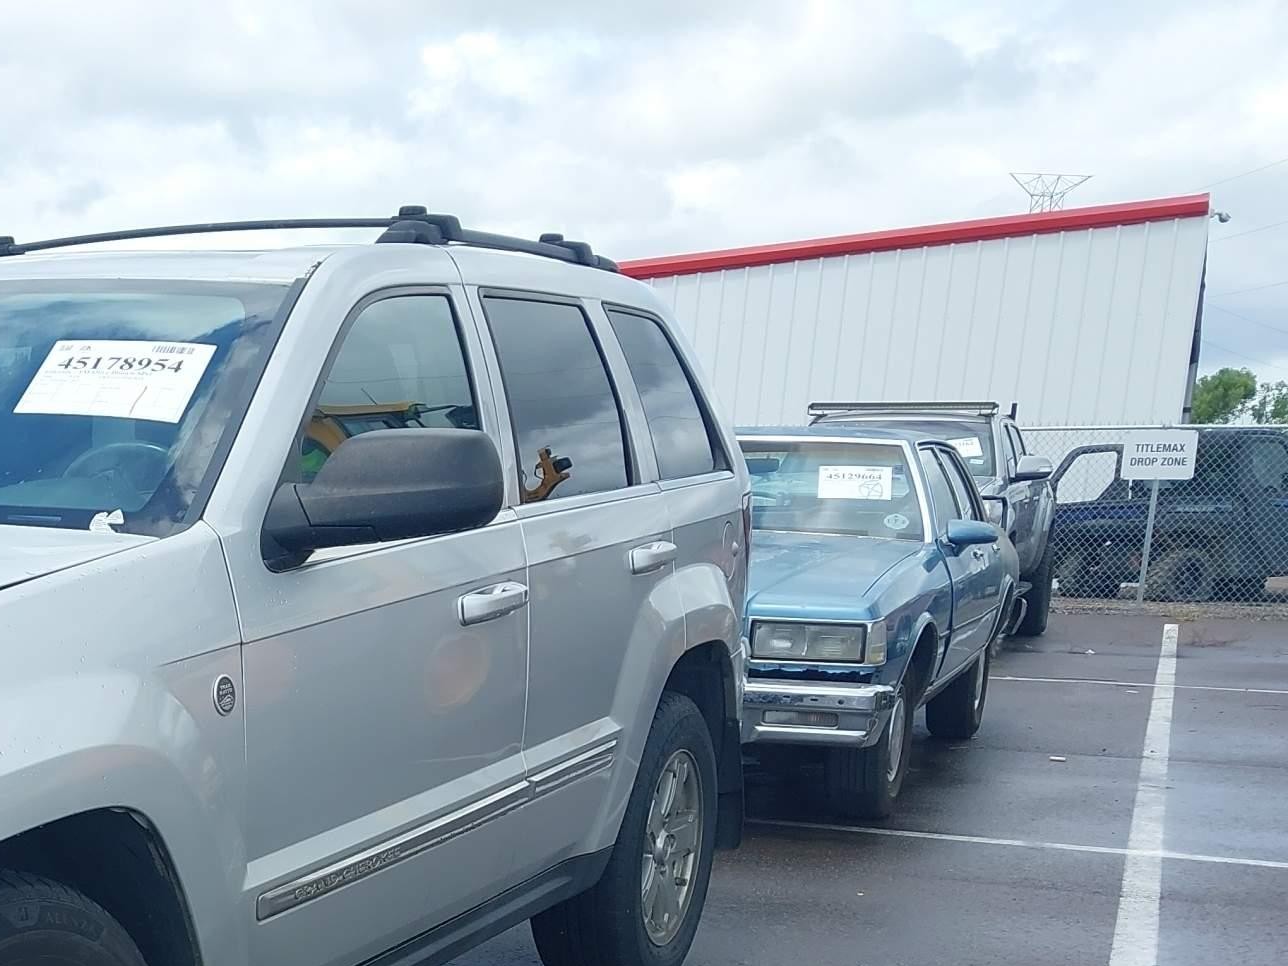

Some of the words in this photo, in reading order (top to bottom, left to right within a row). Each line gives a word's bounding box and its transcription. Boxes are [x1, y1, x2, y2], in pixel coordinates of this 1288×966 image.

[57, 356, 185, 373] 45178954
[1135, 443, 1186, 453] TITLEMAX
[1129, 457, 1158, 467] DROP
[1160, 457, 1188, 467] ZONE
